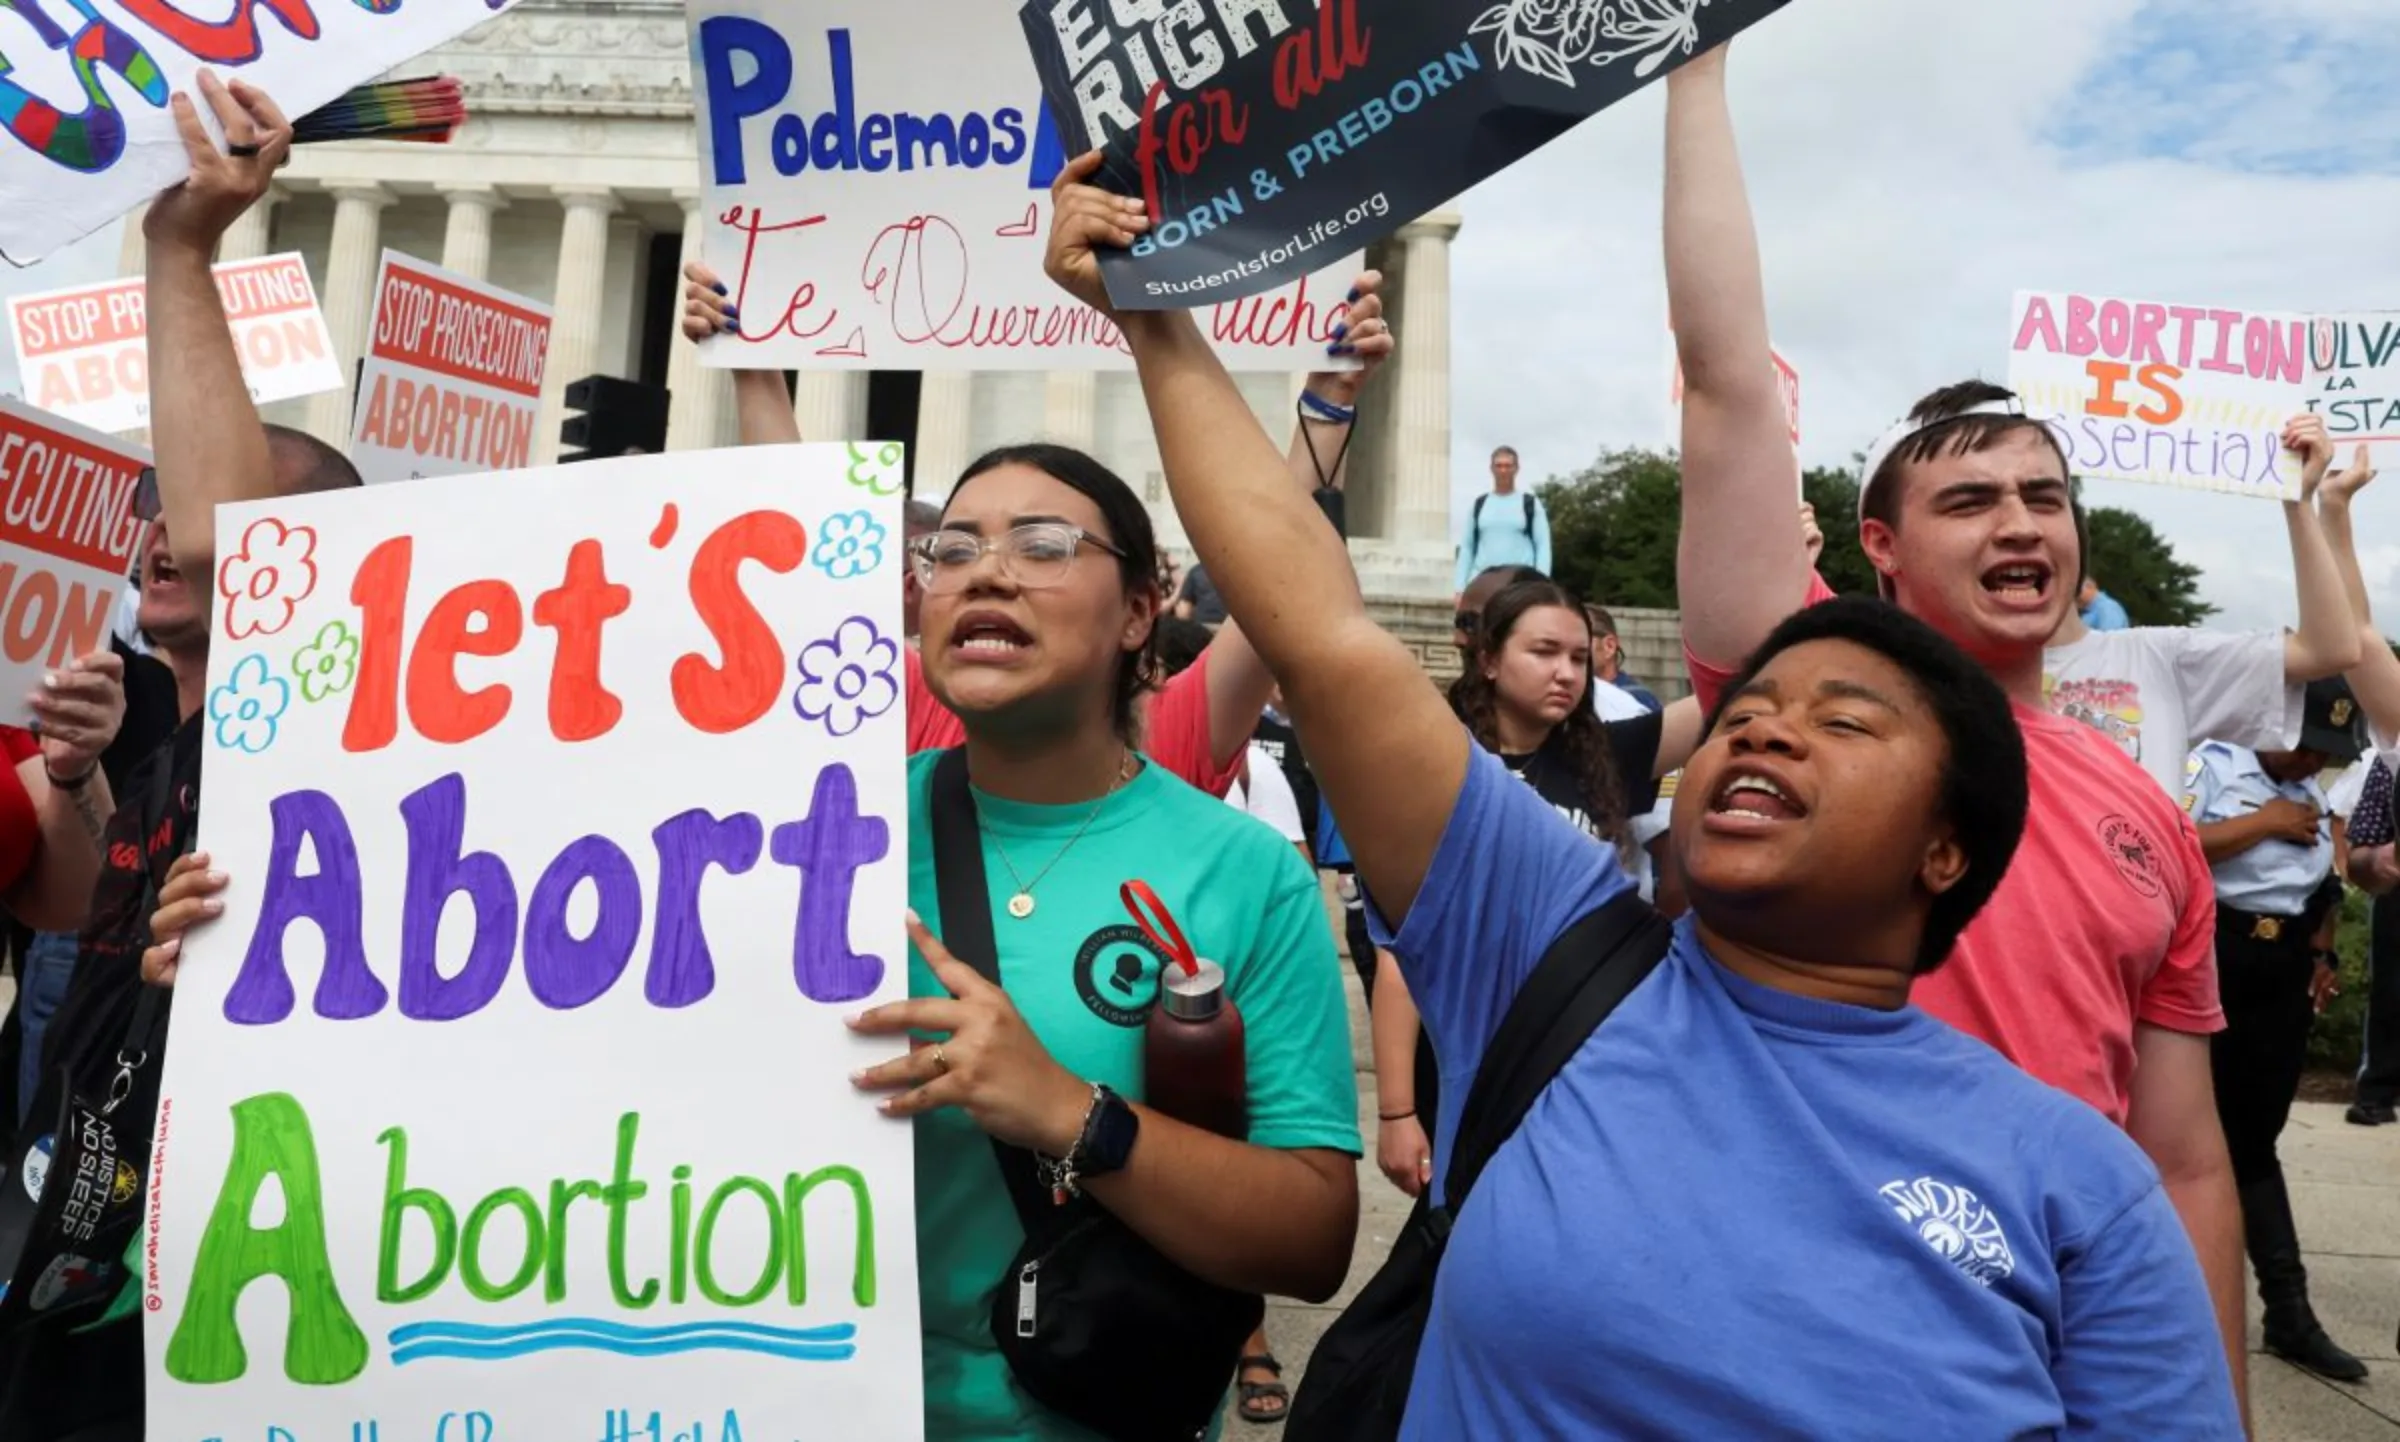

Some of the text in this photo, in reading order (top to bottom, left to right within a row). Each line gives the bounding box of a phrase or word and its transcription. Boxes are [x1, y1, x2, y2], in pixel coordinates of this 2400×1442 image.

[700, 15, 1026, 187] Podemos
[1132, 41, 1480, 257] BORN & PREBORN
[1134, 79, 1248, 223] for
[1272, 0, 1372, 110] all
[862, 215, 1134, 356] Queremo
[1146, 191, 1390, 295] StudentsforLife.org
[22, 300, 100, 349] STOP
[378, 277, 548, 386] STOP PROSECUTING
[2013, 294, 2305, 384] ABORTION
[360, 373, 535, 469] ABORTION
[2085, 358, 2184, 425] IS
[2324, 375, 2356, 390] LA
[222, 762, 889, 1025] Abort
[61, 1109, 99, 1235] NO SLEEP
[74, 1151, 116, 1241] JUSTICE
[165, 1091, 876, 1385] Abortion
